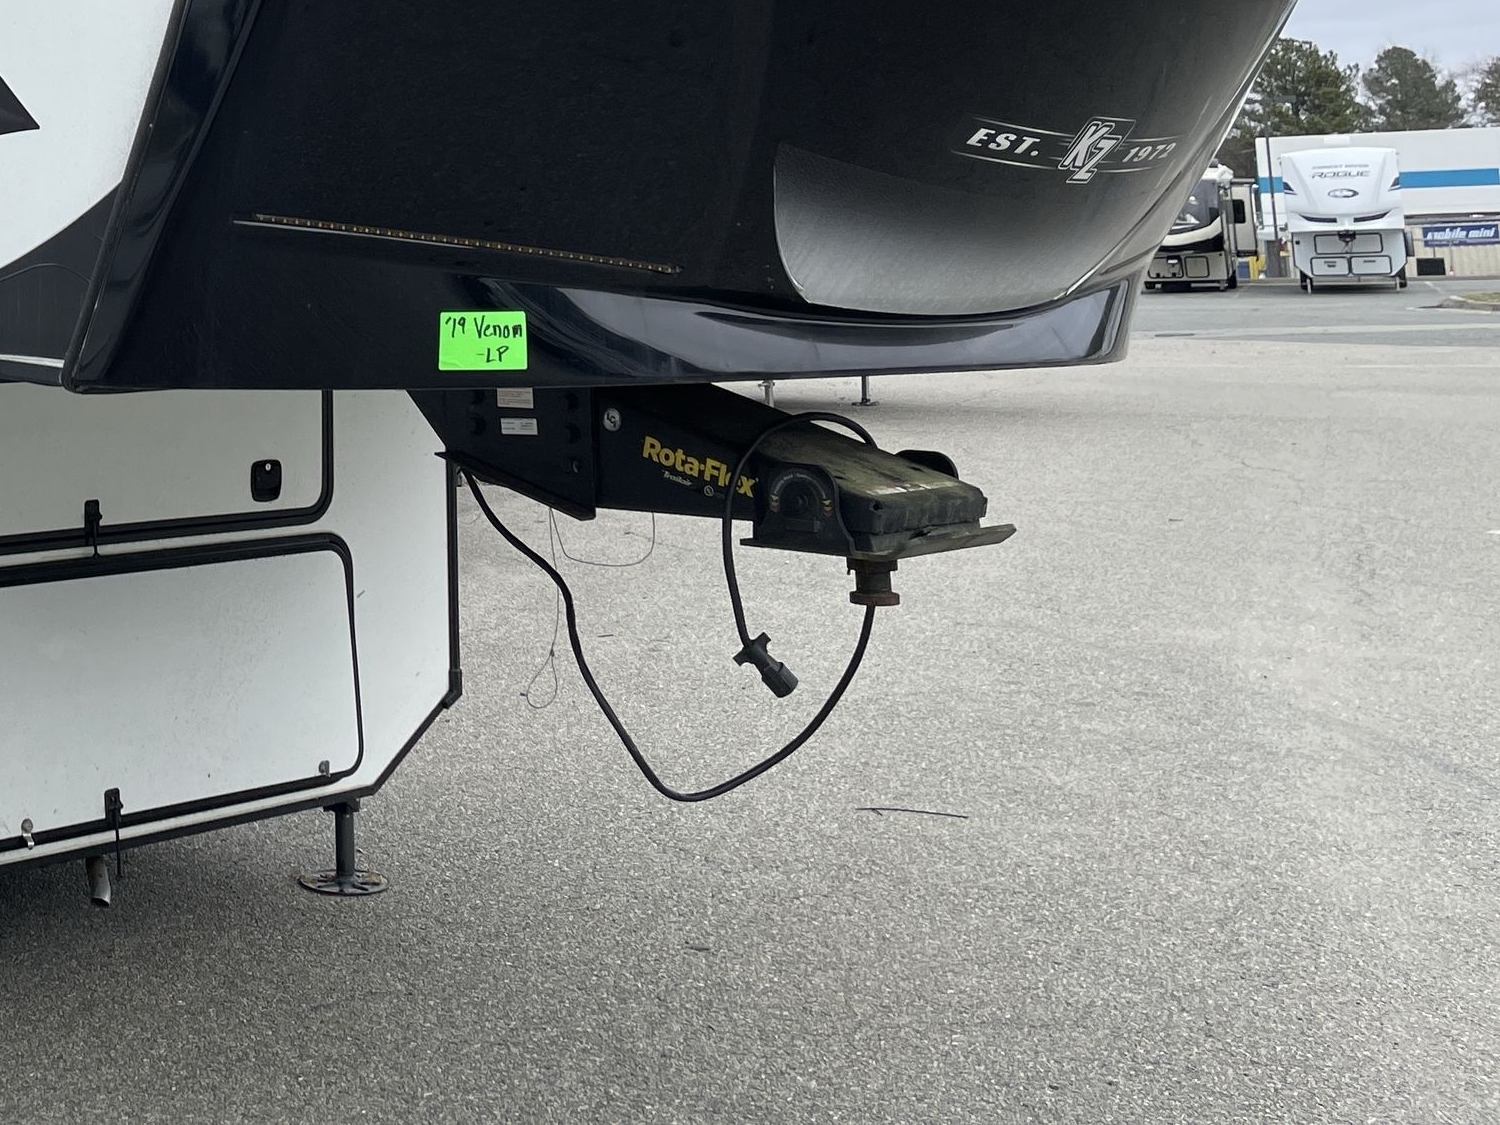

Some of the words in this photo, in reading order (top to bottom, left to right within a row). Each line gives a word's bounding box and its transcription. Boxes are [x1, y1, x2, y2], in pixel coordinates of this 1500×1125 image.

[966, 127, 1041, 157] EST.
[1122, 142, 1177, 163] 1972
[1311, 170, 1370, 179] ROGUE
[1426, 227, 1467, 240] mobile
[1468, 227, 1496, 238] mini
[473, 315, 523, 339] Venom
